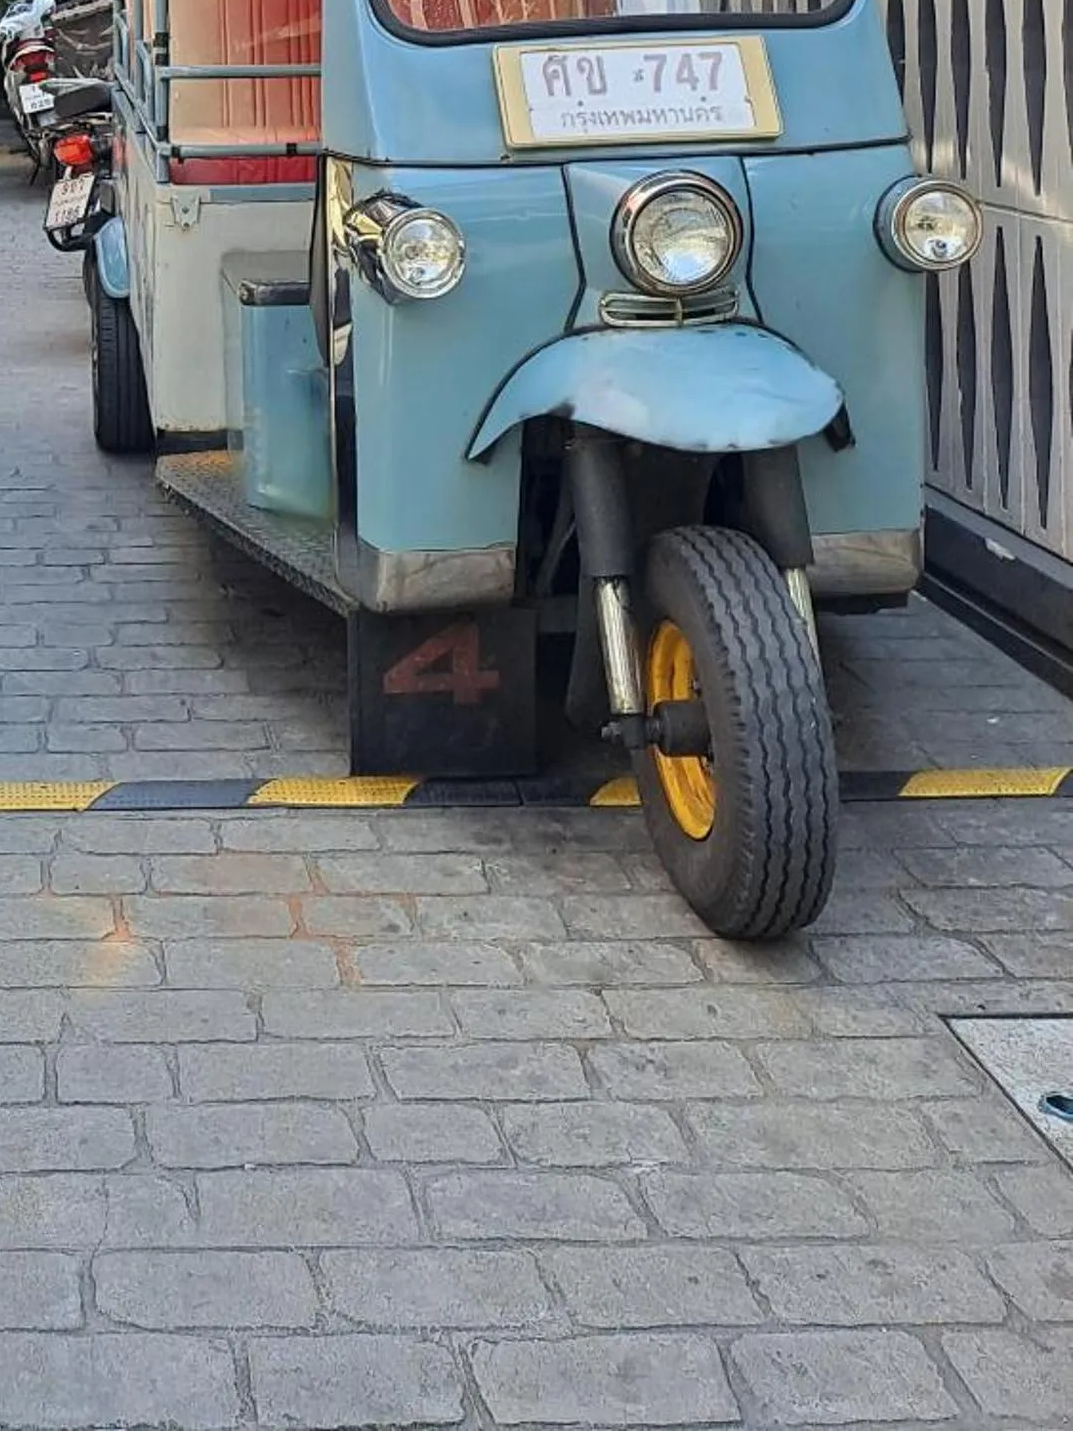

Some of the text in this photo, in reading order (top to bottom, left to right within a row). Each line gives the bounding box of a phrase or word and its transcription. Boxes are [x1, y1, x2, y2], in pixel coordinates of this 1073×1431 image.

[643, 51, 723, 94] 747
[560, 105, 724, 133] กรุงเทพมหานคร
[383, 624, 500, 705] 4
